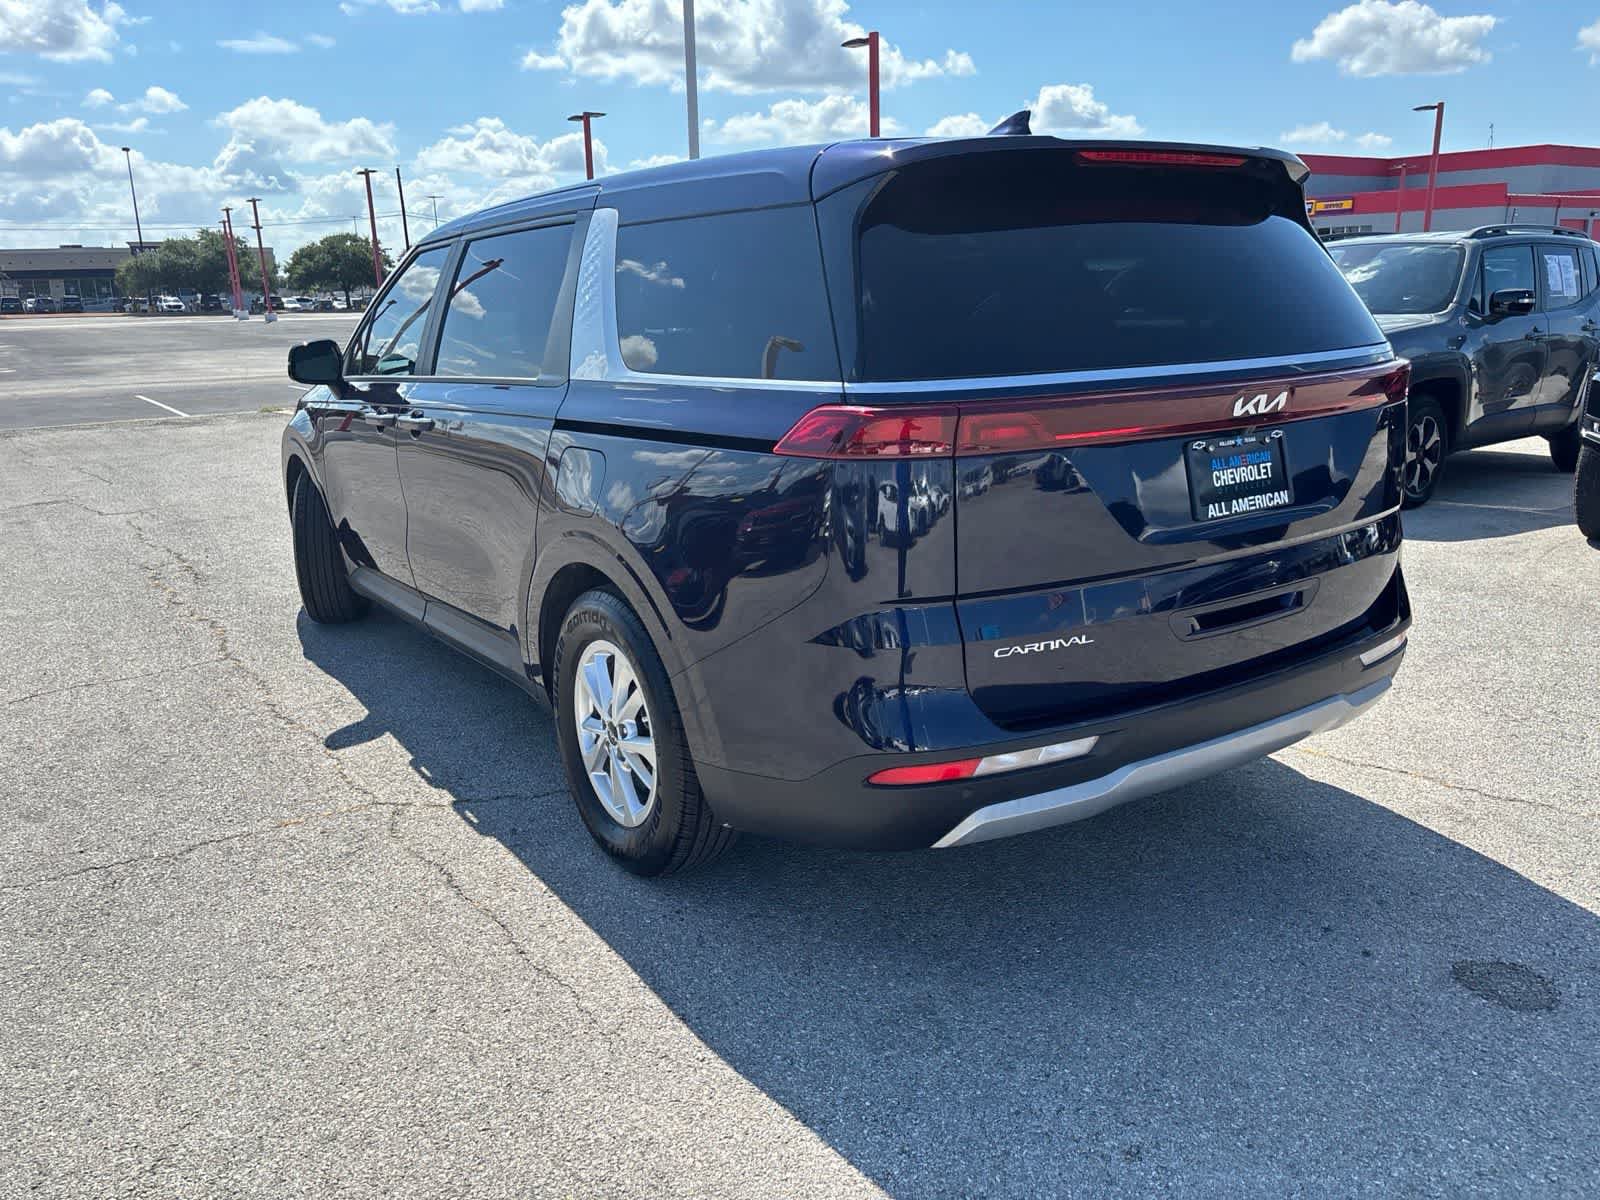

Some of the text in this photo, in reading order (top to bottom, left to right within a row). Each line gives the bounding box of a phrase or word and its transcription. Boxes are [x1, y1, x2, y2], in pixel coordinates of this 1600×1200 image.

[1233, 391, 1288, 417] KIA
[1211, 450, 1272, 470] ALL AMERICAN
[1213, 463, 1272, 487] CHEVROLET
[1208, 490, 1289, 518] ALL AMERICAN
[994, 635, 1094, 658] CARNIVAL
